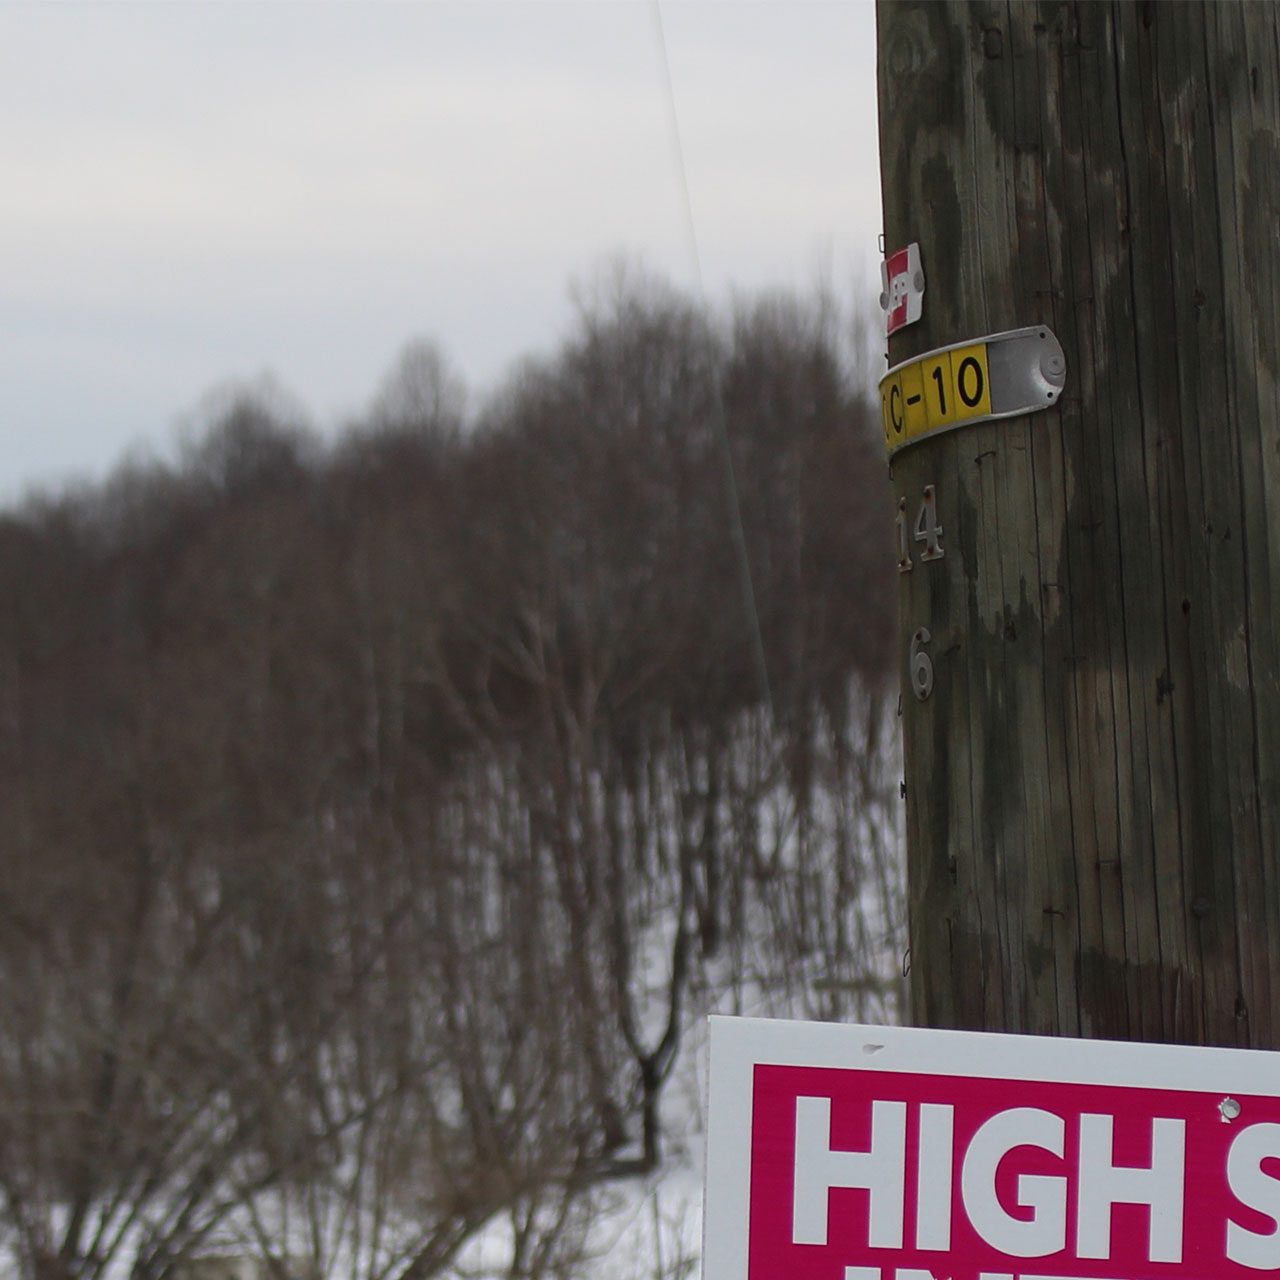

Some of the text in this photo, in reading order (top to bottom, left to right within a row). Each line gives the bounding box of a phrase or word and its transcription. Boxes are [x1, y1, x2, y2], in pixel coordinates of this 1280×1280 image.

[896, 484, 945, 572] 14
[910, 626, 934, 701] 6
[791, 1095, 1186, 1264] HIGH
